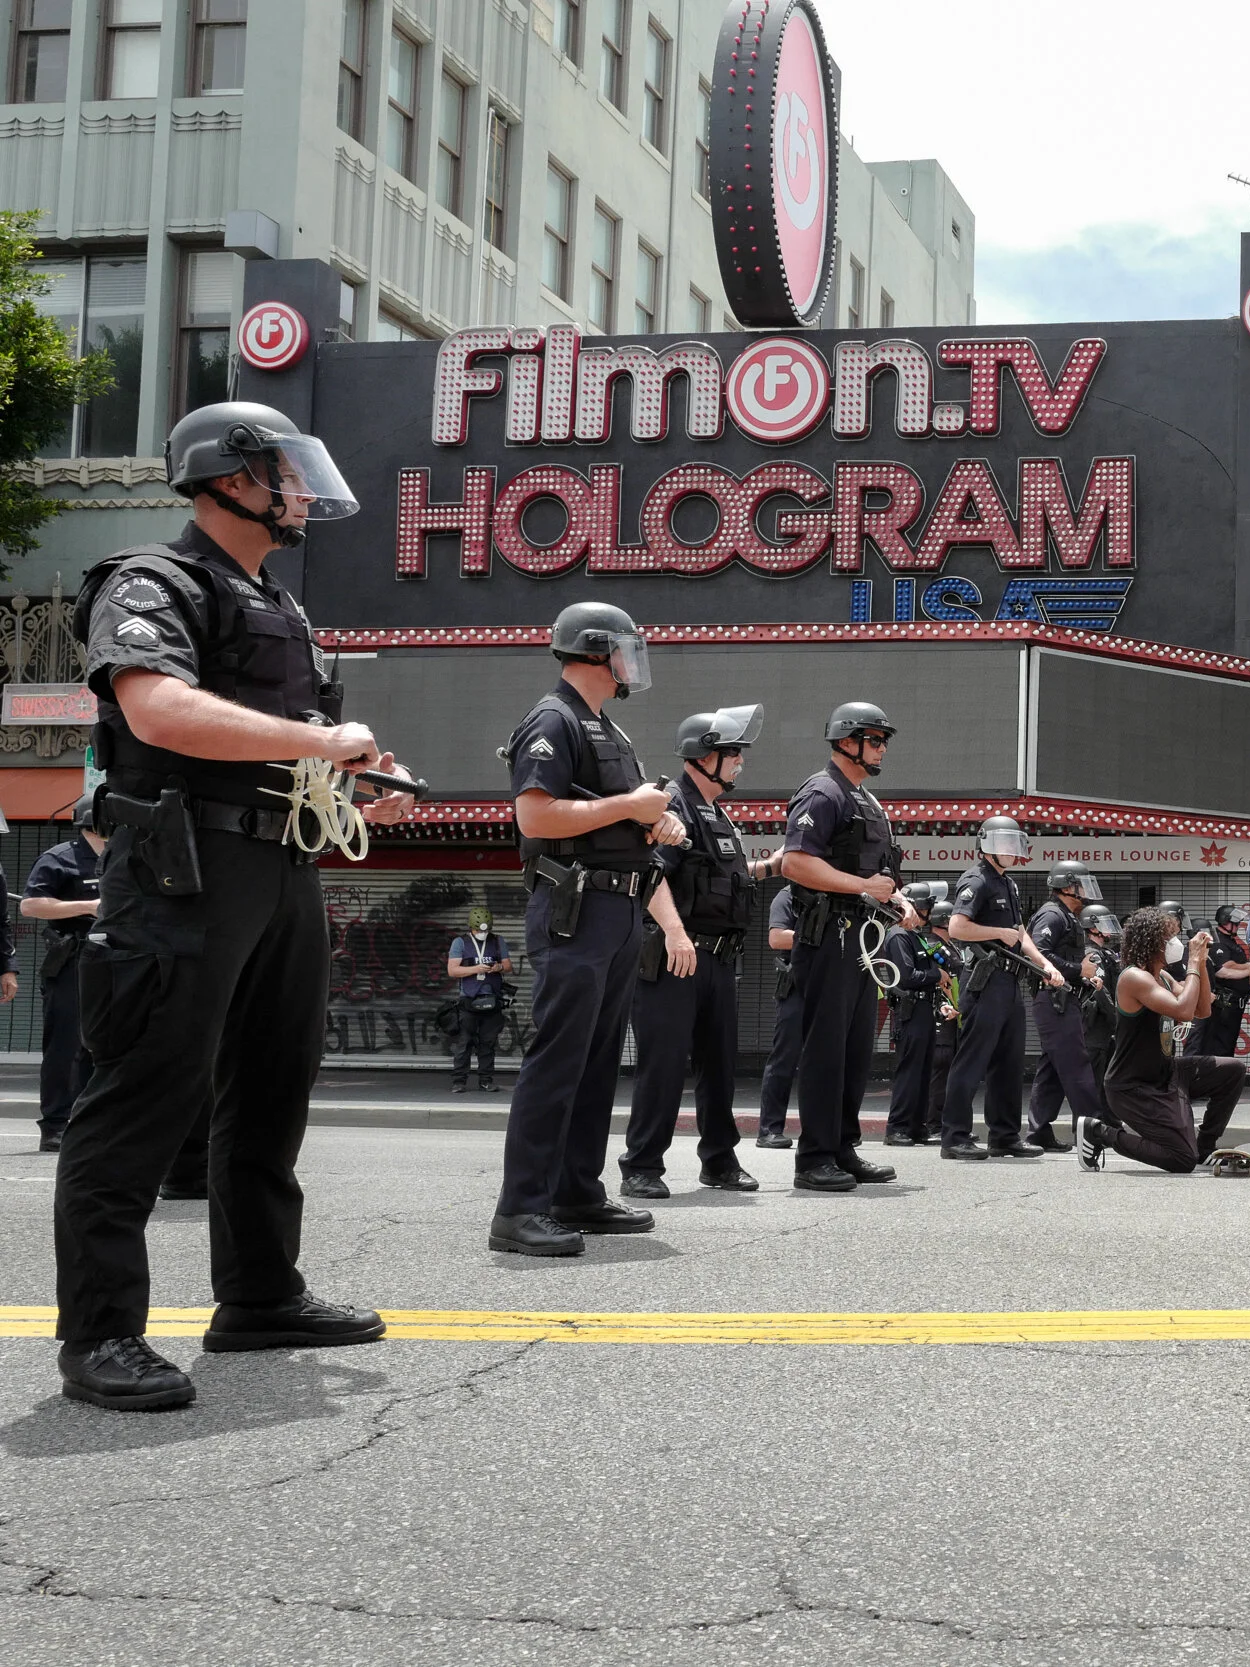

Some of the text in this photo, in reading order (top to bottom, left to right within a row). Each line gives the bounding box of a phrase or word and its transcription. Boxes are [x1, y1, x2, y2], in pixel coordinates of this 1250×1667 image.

[396, 455, 1137, 581] HOLOGRAM
[112, 577, 172, 604] LOS ANGELES
[124, 597, 157, 609] POLICE
[850, 577, 1134, 632] USA
[902, 850, 1191, 862] KE LOUNG MEMBER LOUNGE
[475, 956, 493, 964] PESS
